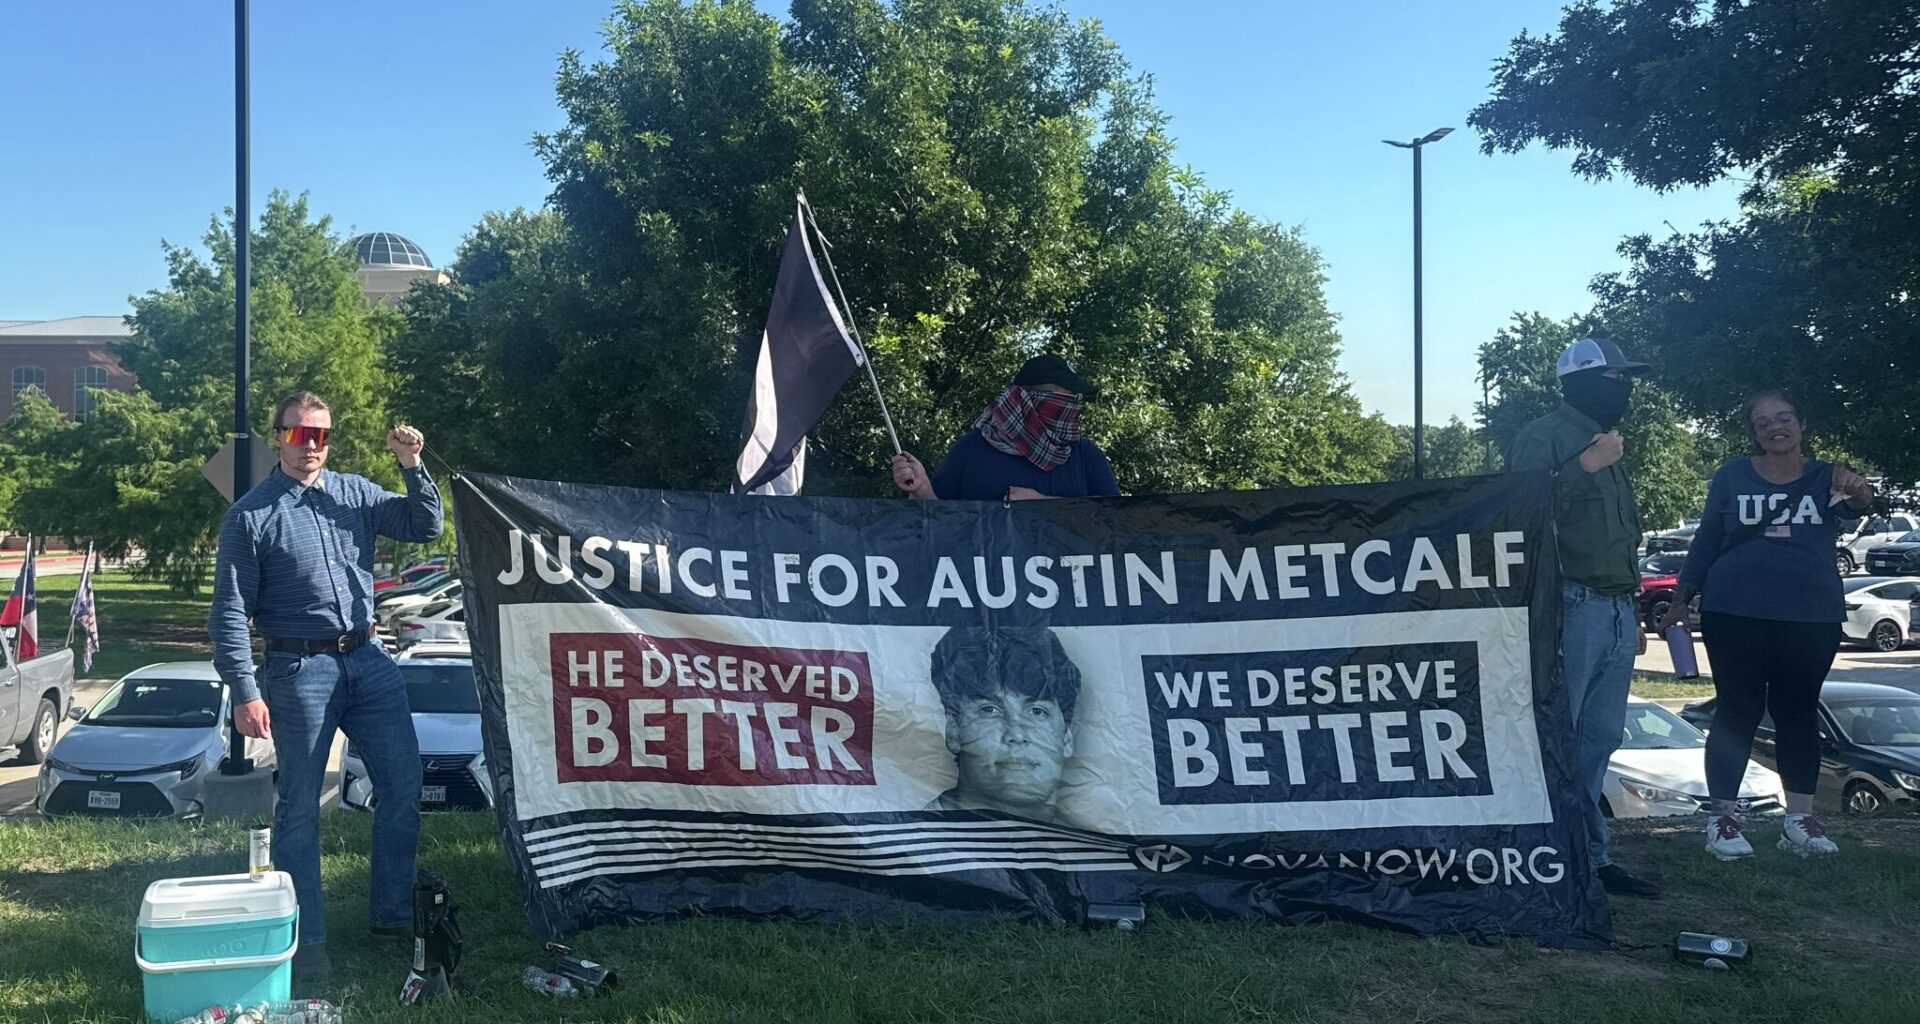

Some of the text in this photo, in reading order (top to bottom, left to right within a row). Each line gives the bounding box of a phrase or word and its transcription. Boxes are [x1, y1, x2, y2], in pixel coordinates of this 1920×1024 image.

[1737, 493, 1823, 525] USA
[498, 529, 1524, 609] JUSTICE FOR AUSTIN METCALF
[567, 649, 859, 702] HE DESERVED
[1154, 660, 1457, 709] WE DESERVE
[571, 698, 864, 772] BETTER
[1166, 709, 1478, 789] BETTER
